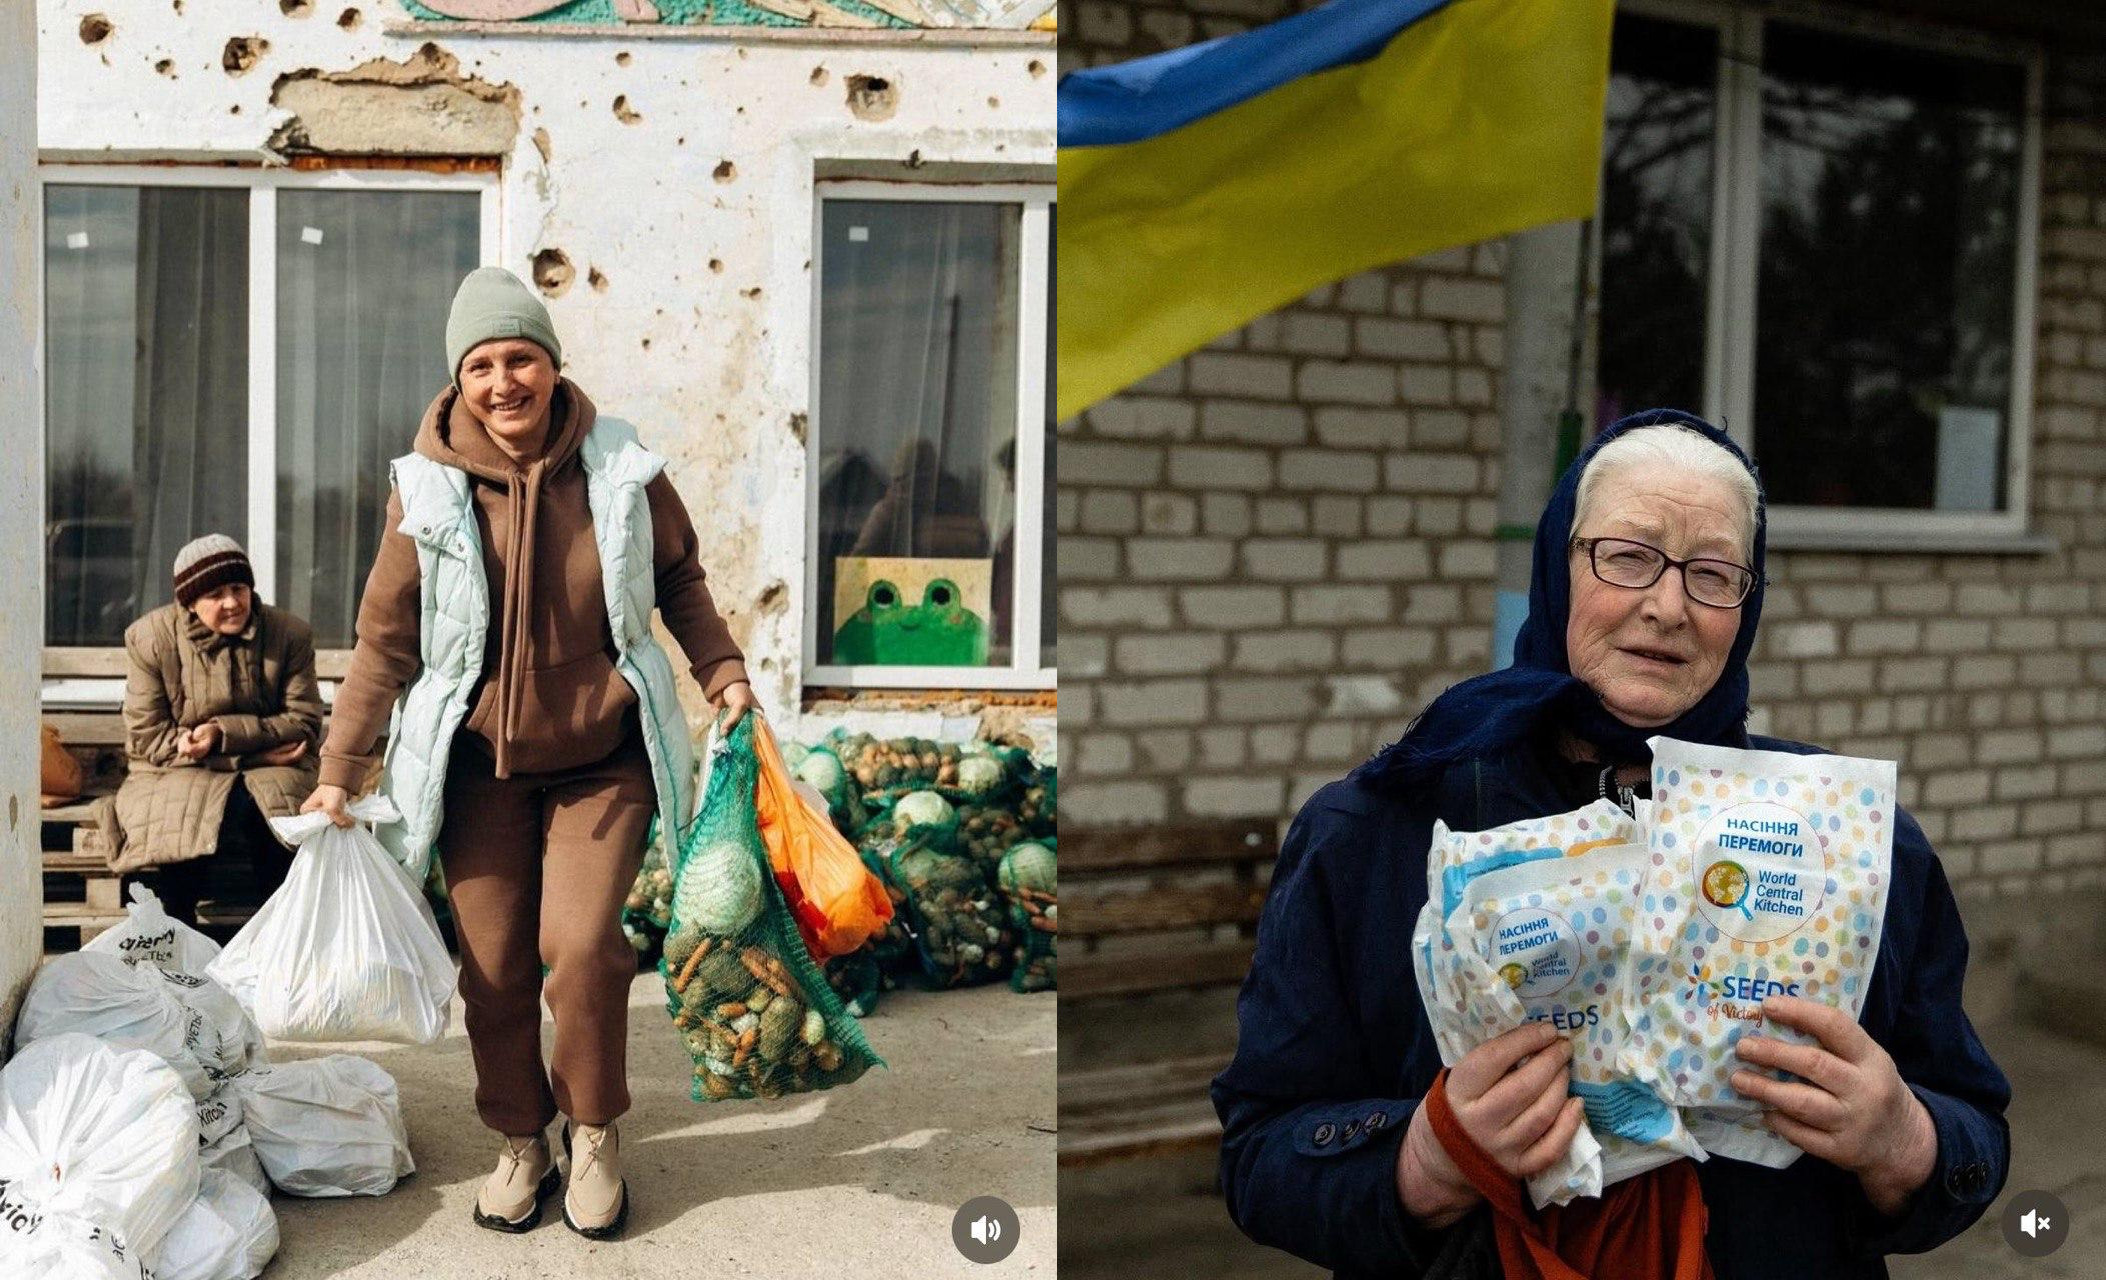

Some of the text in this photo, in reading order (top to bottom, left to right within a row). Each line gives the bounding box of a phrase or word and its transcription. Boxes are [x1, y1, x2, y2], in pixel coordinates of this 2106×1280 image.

[1726, 818, 1798, 836] НАСІННЯ
[1718, 834, 1803, 857] ПЕРЕМОГИ
[1758, 870, 1797, 886] World
[1756, 884, 1803, 901] Central
[1754, 898, 1803, 916] Kitchen
[1528, 1004, 1600, 1031] EDS
[1706, 1001, 1763, 1029] of Victory
